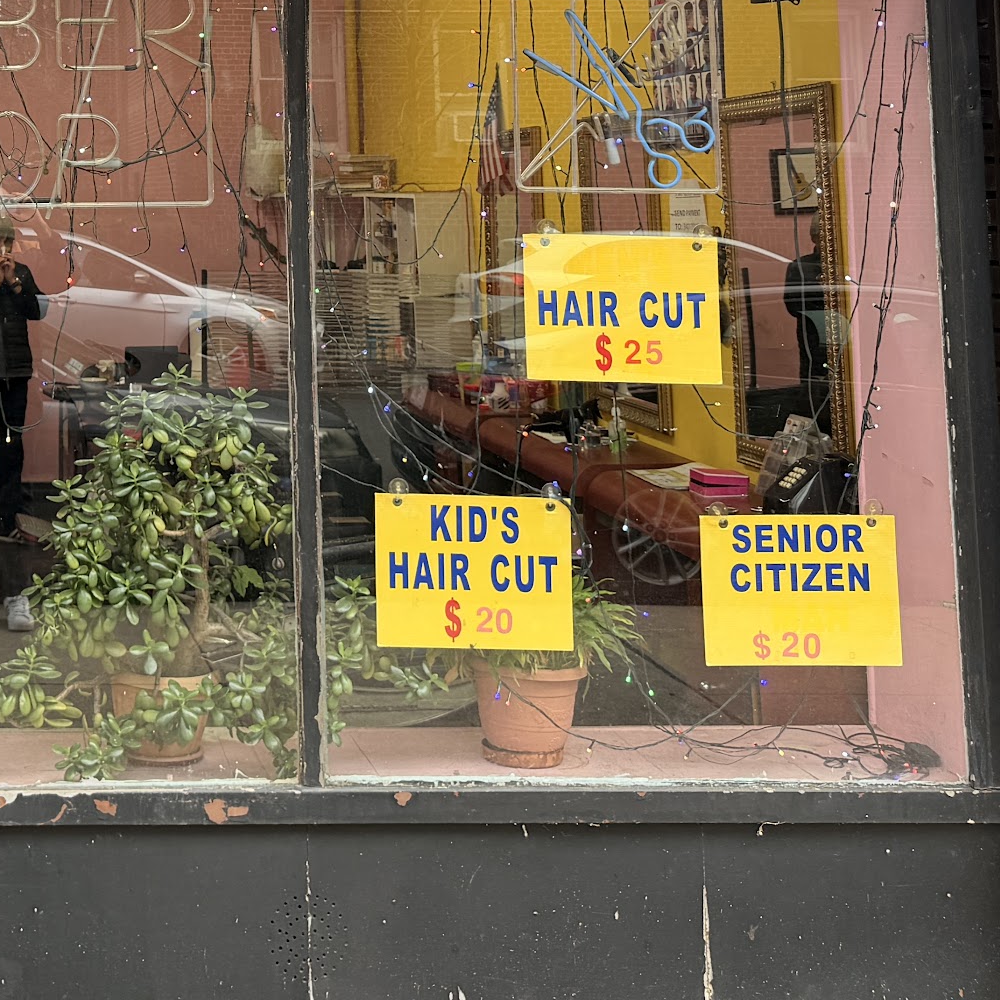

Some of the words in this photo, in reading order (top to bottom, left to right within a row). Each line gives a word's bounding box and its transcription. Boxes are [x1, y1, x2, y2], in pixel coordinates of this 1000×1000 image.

[537, 290, 620, 328] HAIR
[639, 291, 706, 329] CUT
[595, 333, 613, 376] $
[624, 340, 663, 366] 25
[430, 504, 520, 545] KID'S
[731, 523, 865, 554] SENIOR
[388, 552, 471, 591] HAIR
[490, 554, 558, 593] CUT
[730, 562, 871, 593] CITIZEN
[444, 597, 462, 642] $
[475, 606, 513, 635] 20
[752, 629, 771, 660] $
[781, 632, 821, 660] 20
